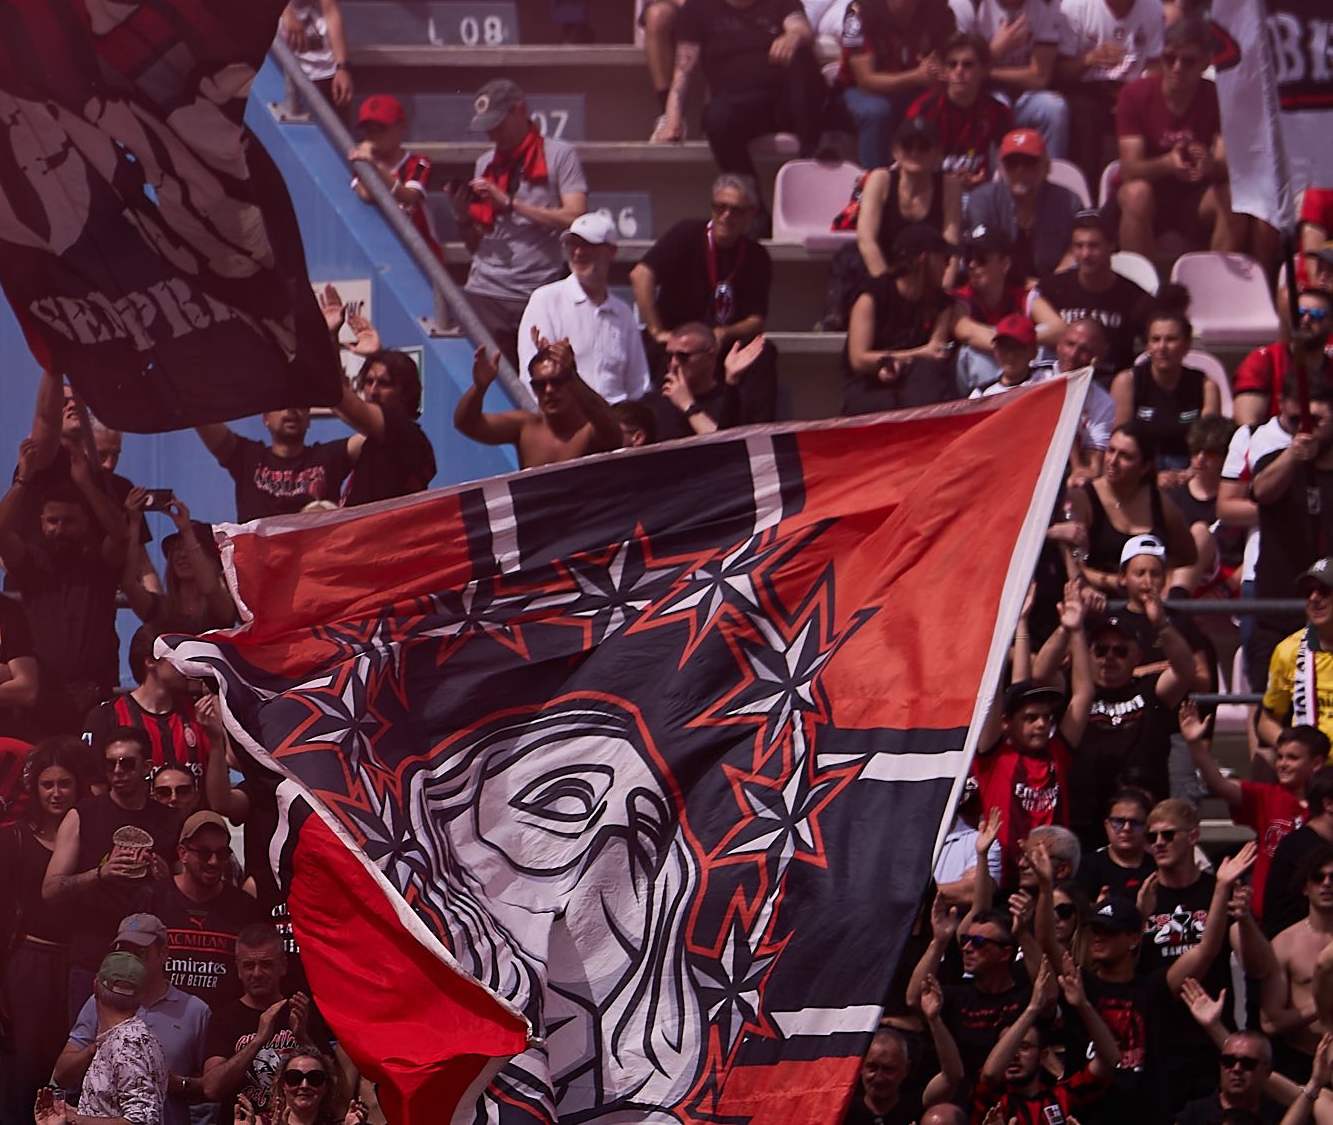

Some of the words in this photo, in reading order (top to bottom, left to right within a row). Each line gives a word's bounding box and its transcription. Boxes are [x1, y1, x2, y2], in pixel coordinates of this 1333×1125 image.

[459, 15, 504, 46] 08
[165, 956, 227, 975] Emirates
[170, 973, 187, 987] FLY
[187, 974, 219, 989] BETTER
